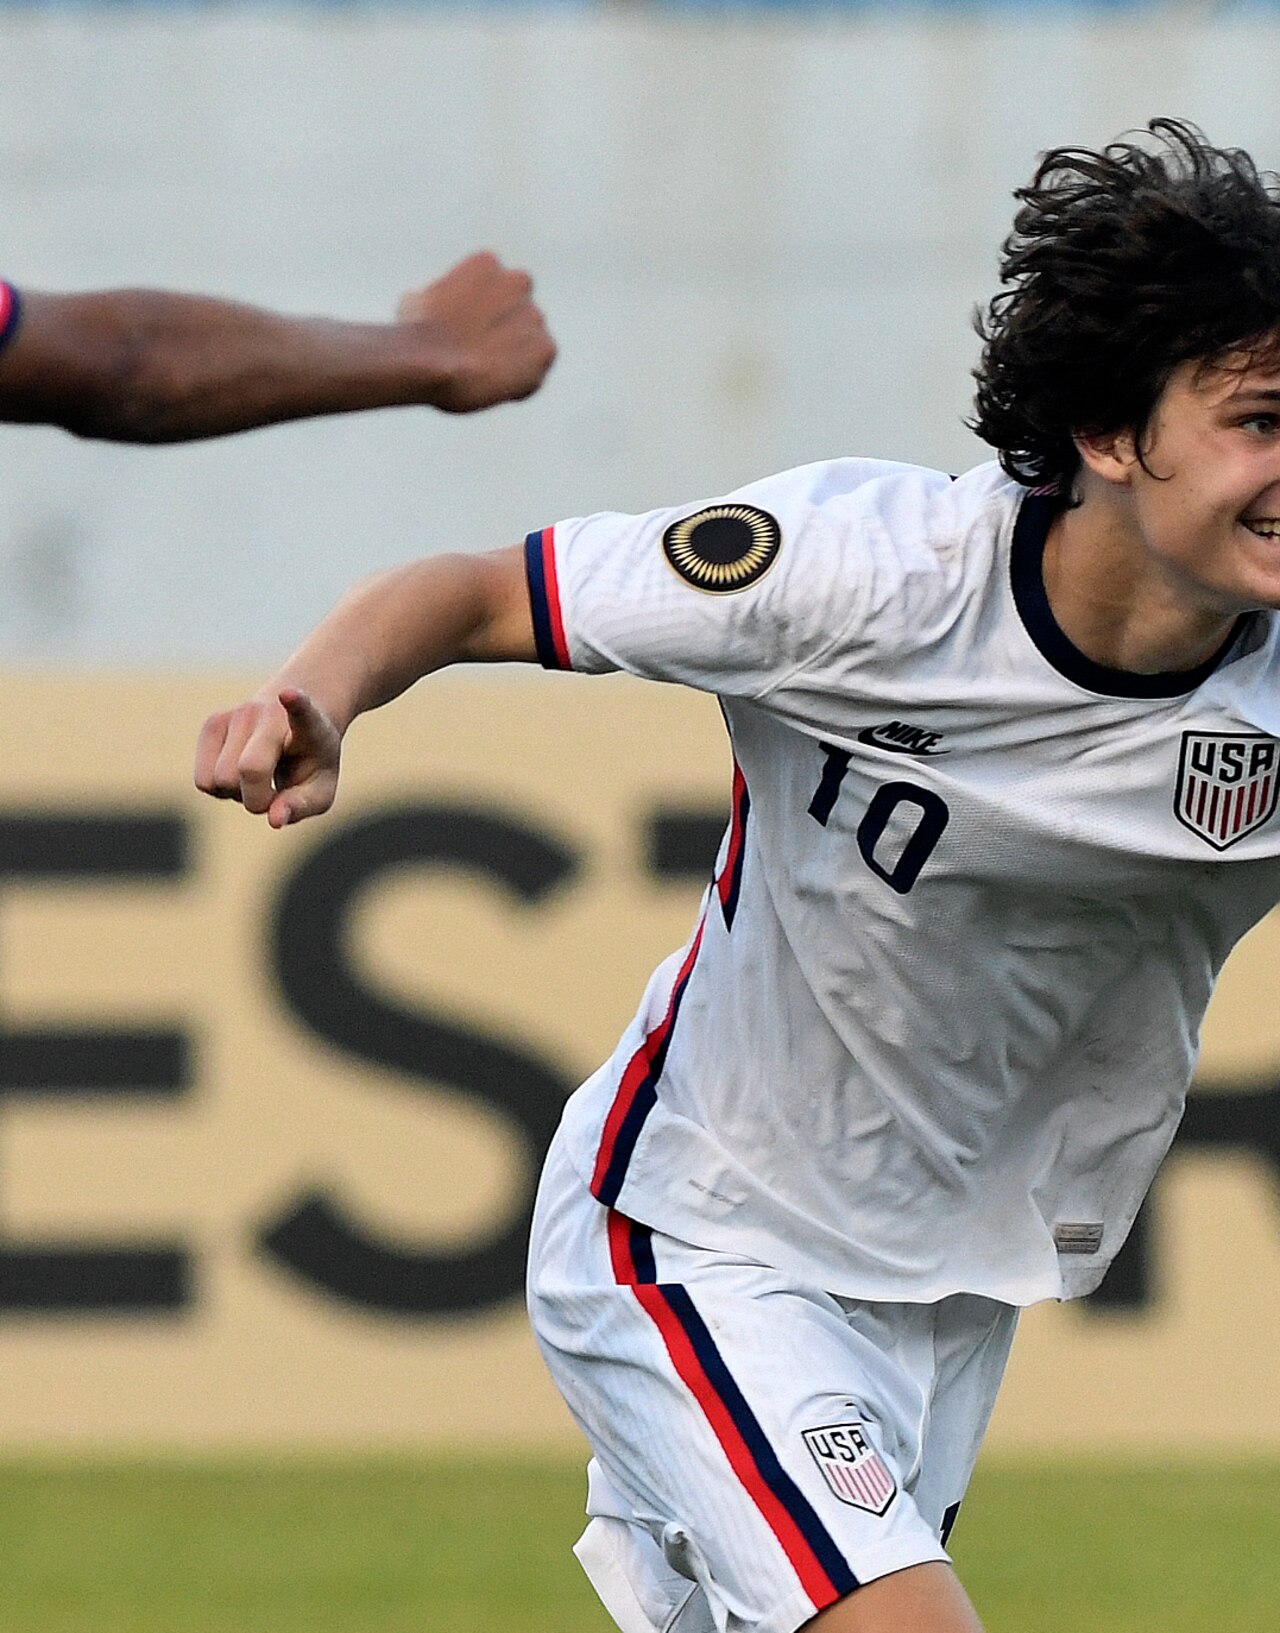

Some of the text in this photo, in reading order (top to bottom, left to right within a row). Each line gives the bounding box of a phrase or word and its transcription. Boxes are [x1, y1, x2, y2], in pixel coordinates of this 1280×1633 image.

[875, 720, 945, 751] NIKE
[1190, 741, 1275, 784] USA
[807, 741, 949, 895] 10
[811, 1429, 870, 1463] USA
